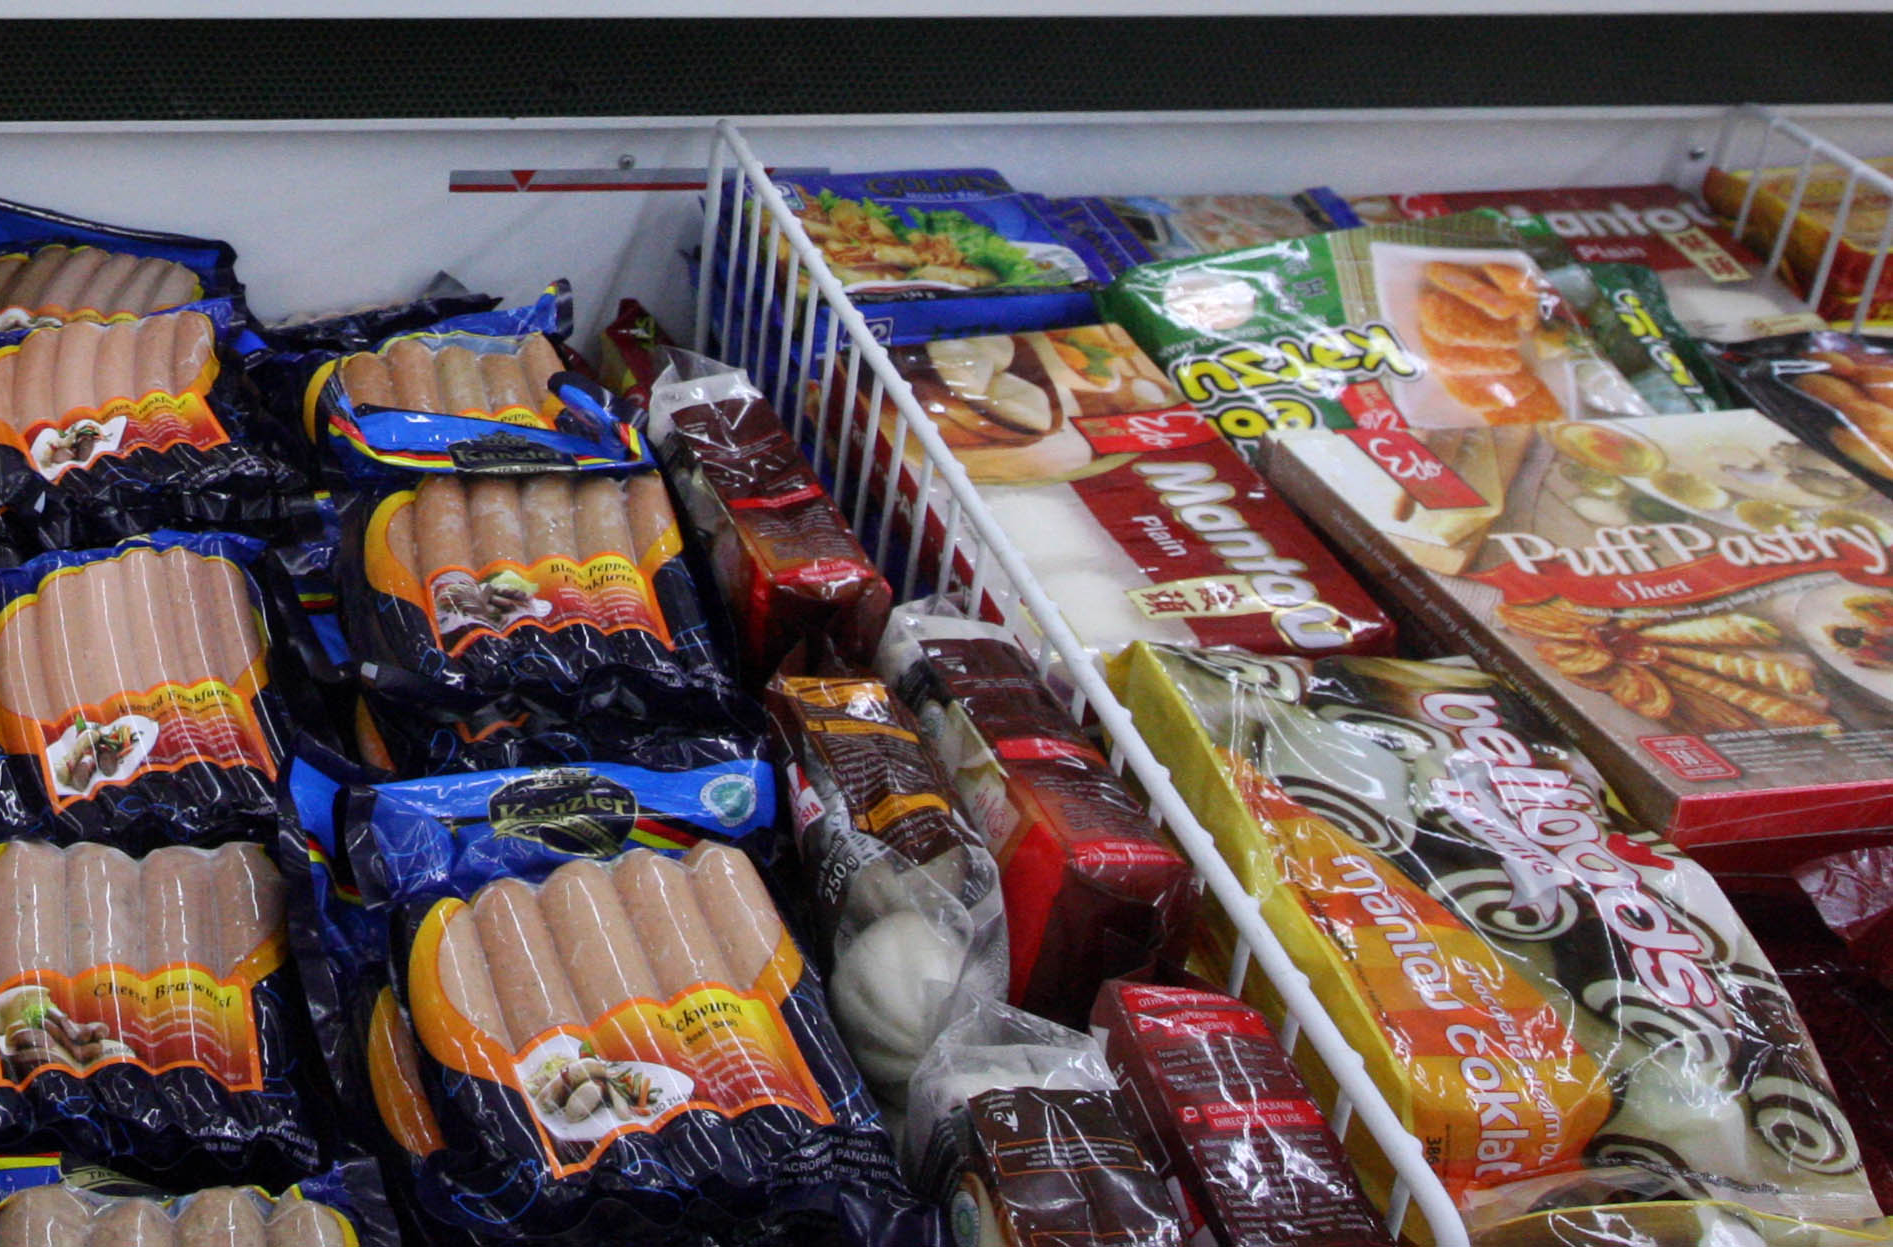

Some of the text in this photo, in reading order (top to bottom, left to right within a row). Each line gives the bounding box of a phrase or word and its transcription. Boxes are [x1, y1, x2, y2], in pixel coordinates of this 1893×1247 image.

[1368, 437, 1444, 481] Edo
[1131, 461, 1355, 651] Mantou
[1132, 513, 1188, 559] Plain
[1488, 523, 1890, 576] Puff Pastry
[1612, 580, 1692, 602] Sheet
[497, 793, 629, 821] Kanzler
[1421, 691, 1717, 1007] belfoods
[824, 859, 848, 904] 250
[1332, 853, 1531, 1178] mantou coklat
